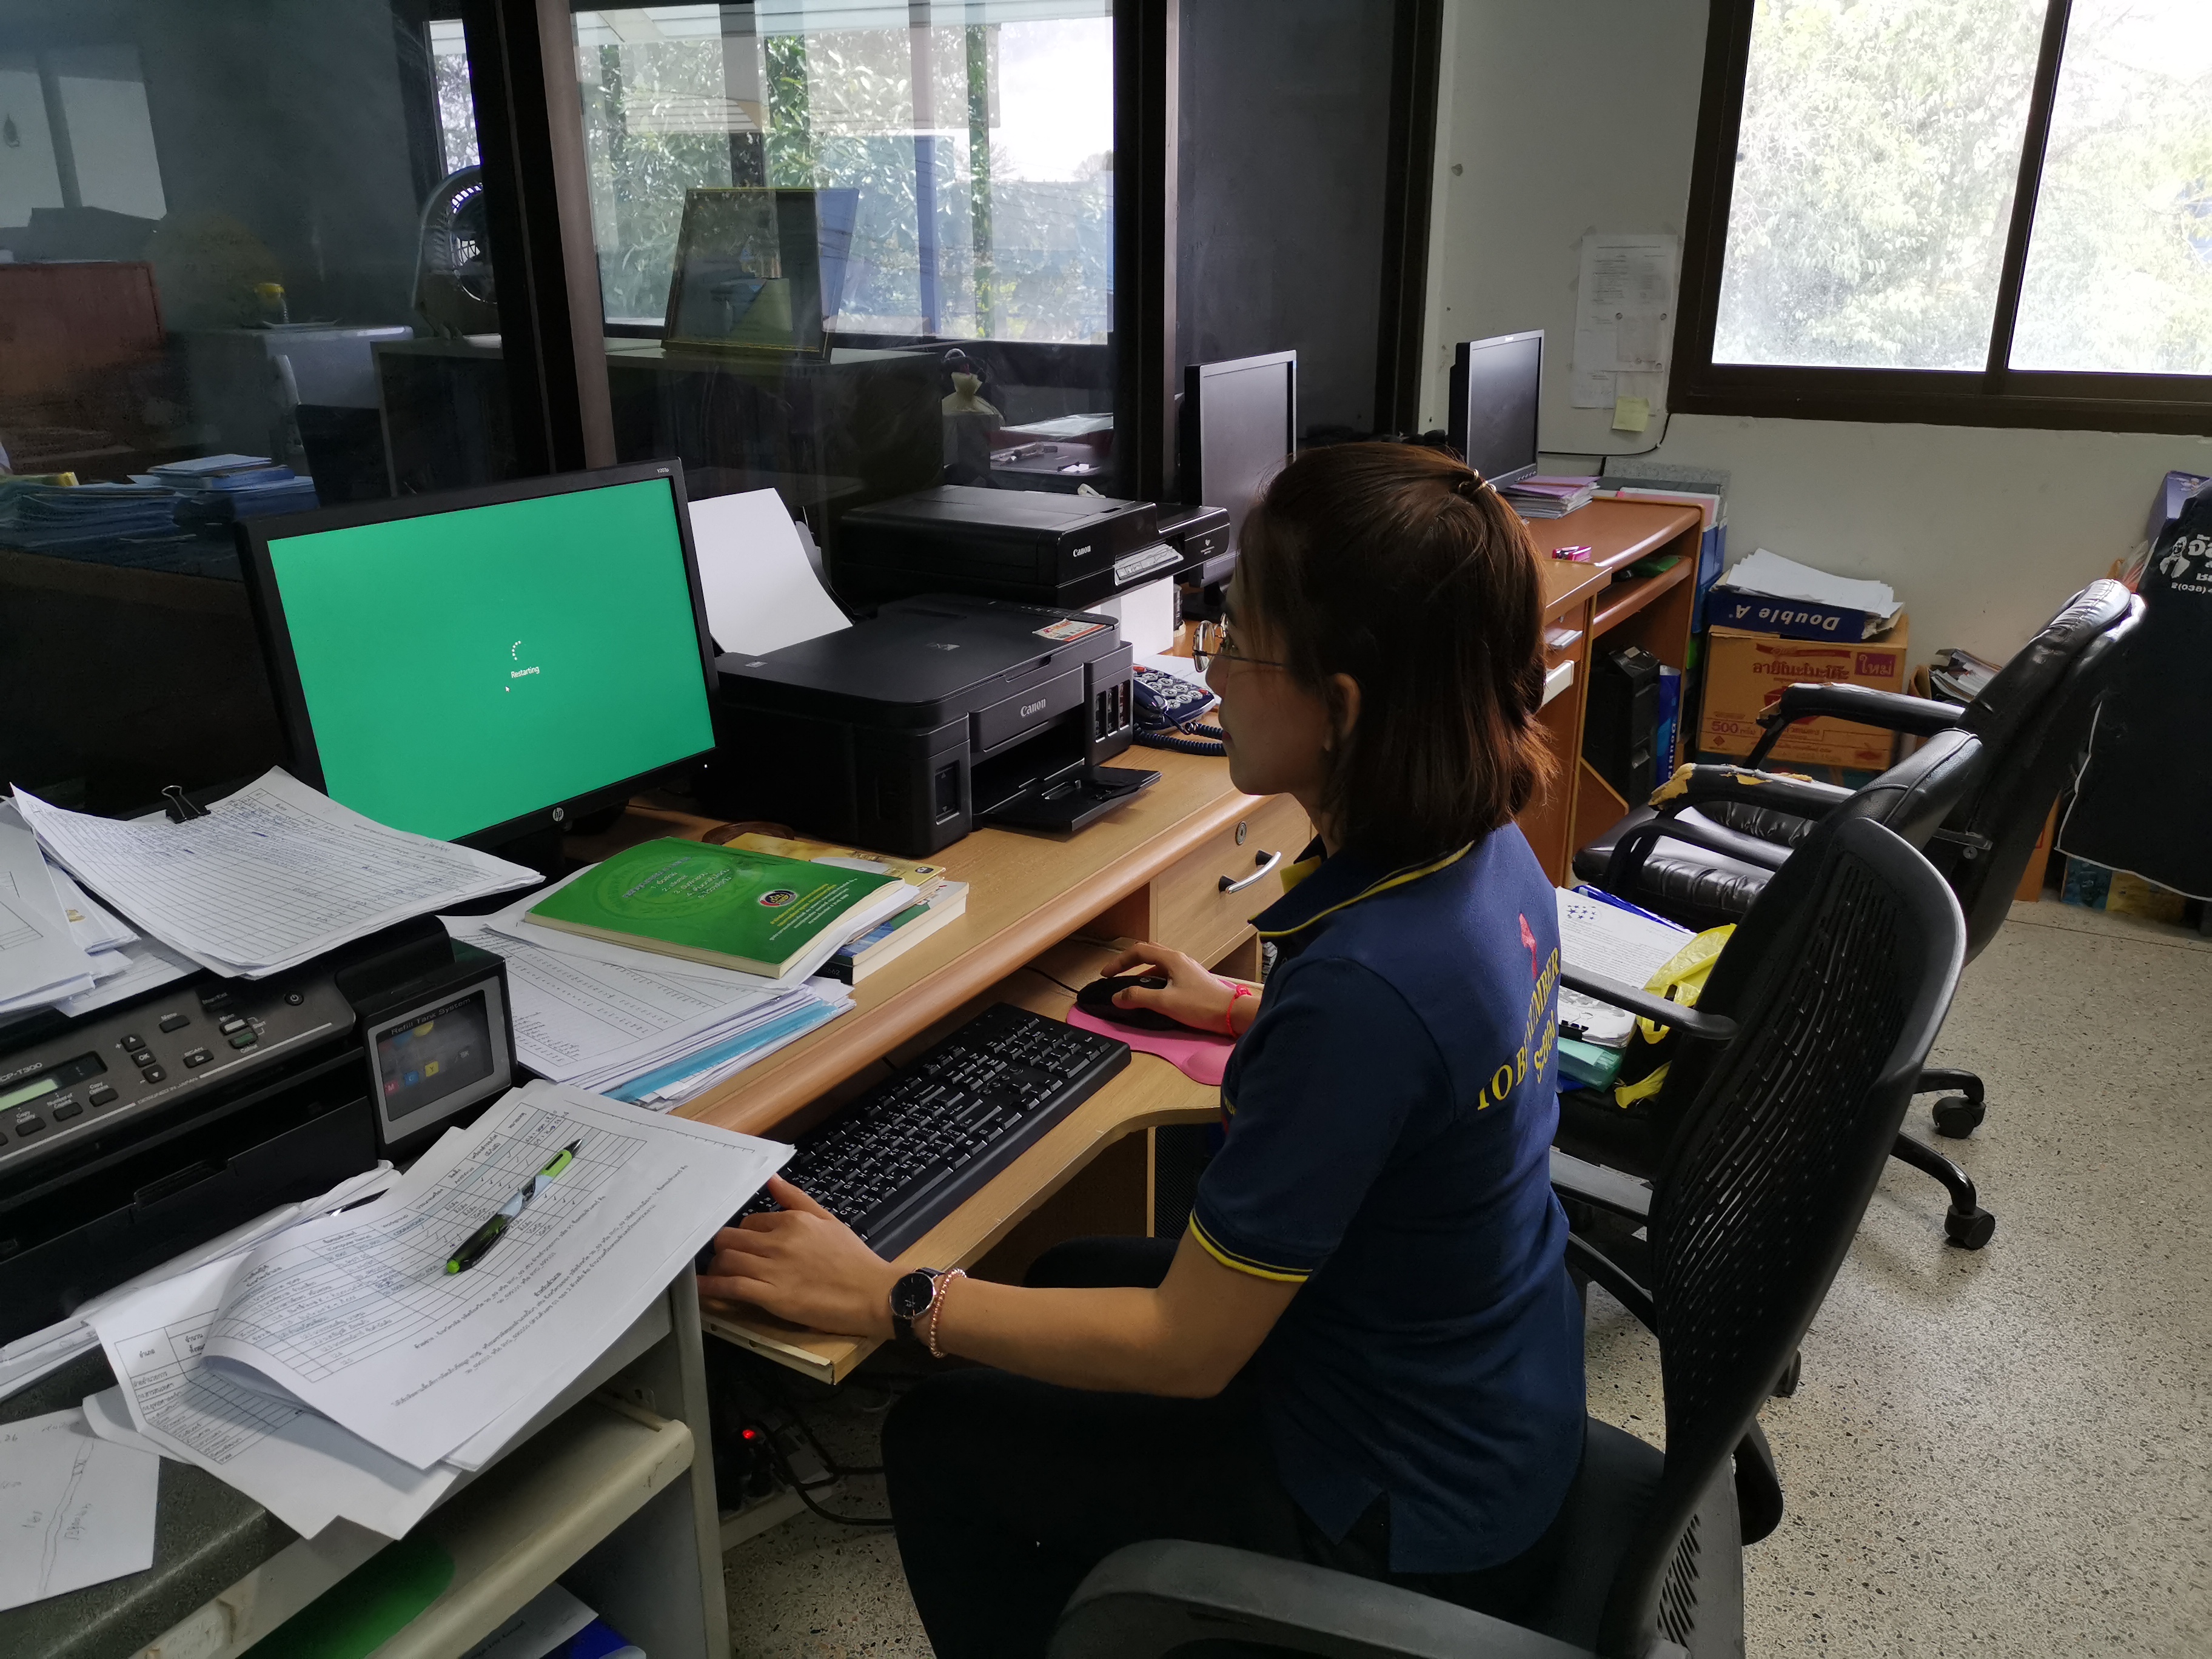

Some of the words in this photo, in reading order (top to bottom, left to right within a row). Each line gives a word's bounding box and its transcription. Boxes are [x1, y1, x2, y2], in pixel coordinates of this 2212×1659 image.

[1073, 545, 1091, 557] Canon
[1735, 605, 1751, 619] A
[1758, 607, 1842, 631] Double
[1858, 654, 1892, 675] ใหม่
[511, 666, 540, 679] Restarting
[1021, 698, 1046, 717] Canon
[1711, 720, 1738, 734] 500
[553, 808, 563, 821] hp
[391, 1022, 414, 1036] Refill
[416, 1013, 437, 1025] Tank
[438, 997, 471, 1016] System
[138, 1053, 150, 1061] OK
